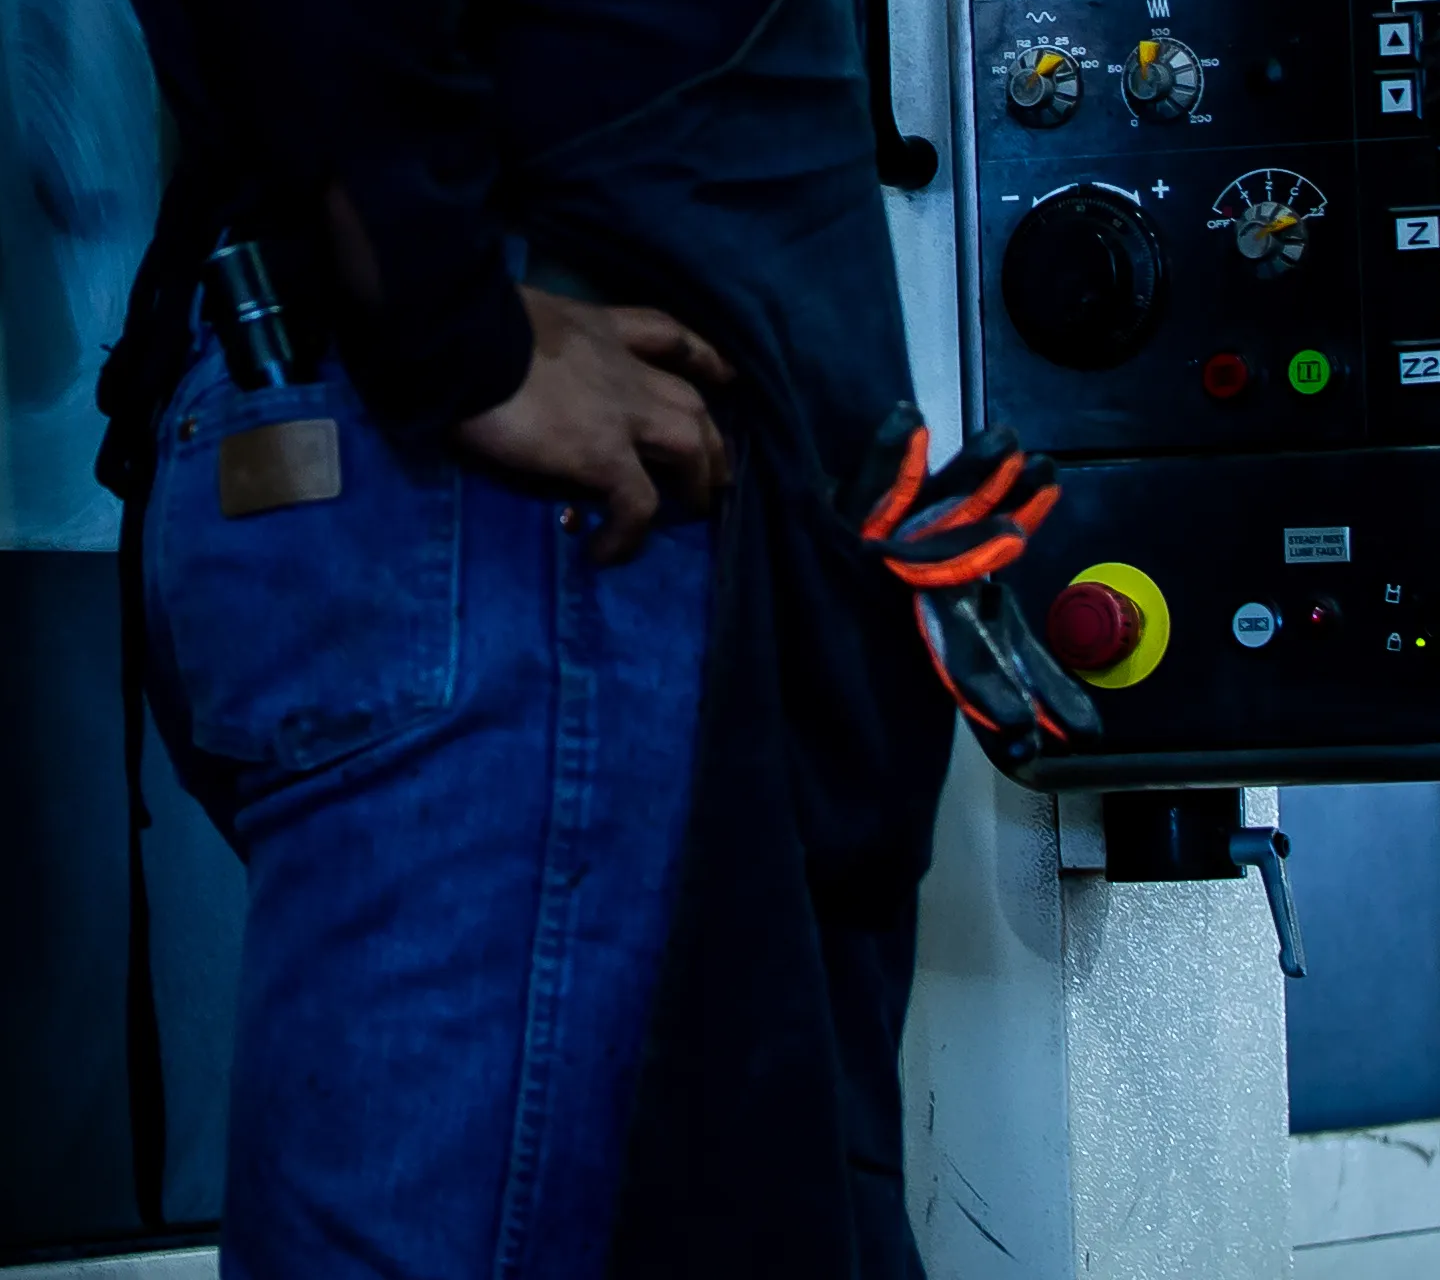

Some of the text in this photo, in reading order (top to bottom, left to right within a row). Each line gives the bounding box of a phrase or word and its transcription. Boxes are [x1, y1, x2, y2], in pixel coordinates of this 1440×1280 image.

[1150, 26, 1170, 38] 100
[1036, 34, 1049, 45] 10
[1053, 35, 1069, 47] 25
[1080, 59, 1100, 70] 100
[1199, 56, 1220, 68] 150
[1206, 218, 1232, 231] OFF
[1405, 221, 1430, 246] Z
[1401, 355, 1440, 379] Z2
